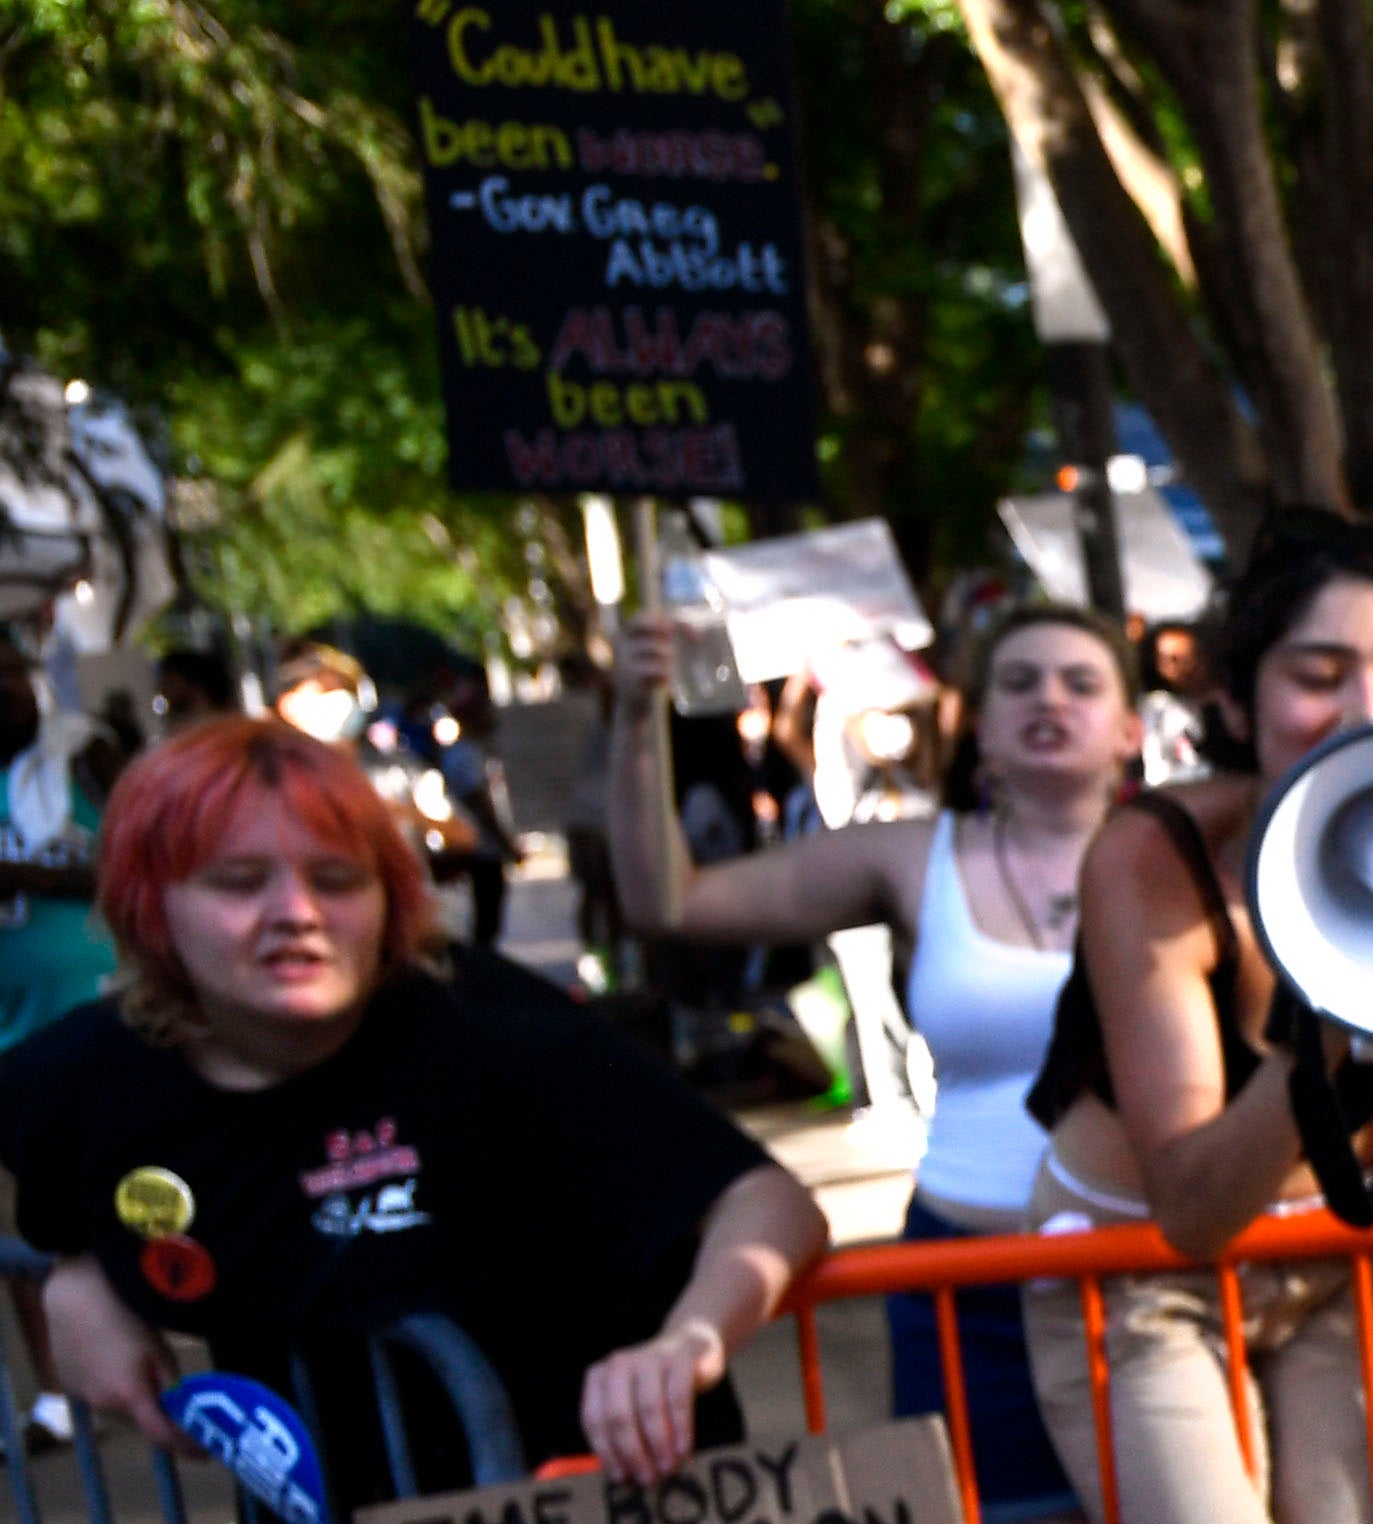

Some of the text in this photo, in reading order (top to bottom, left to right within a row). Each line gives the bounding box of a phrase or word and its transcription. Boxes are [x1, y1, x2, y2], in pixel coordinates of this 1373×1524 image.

[601, 15, 749, 98] have
[419, 97, 573, 169] been
[581, 184, 721, 259] Greg
[605, 238, 790, 295] Abbott
[549, 303, 793, 381] ALWAYS
[547, 371, 708, 430] been
